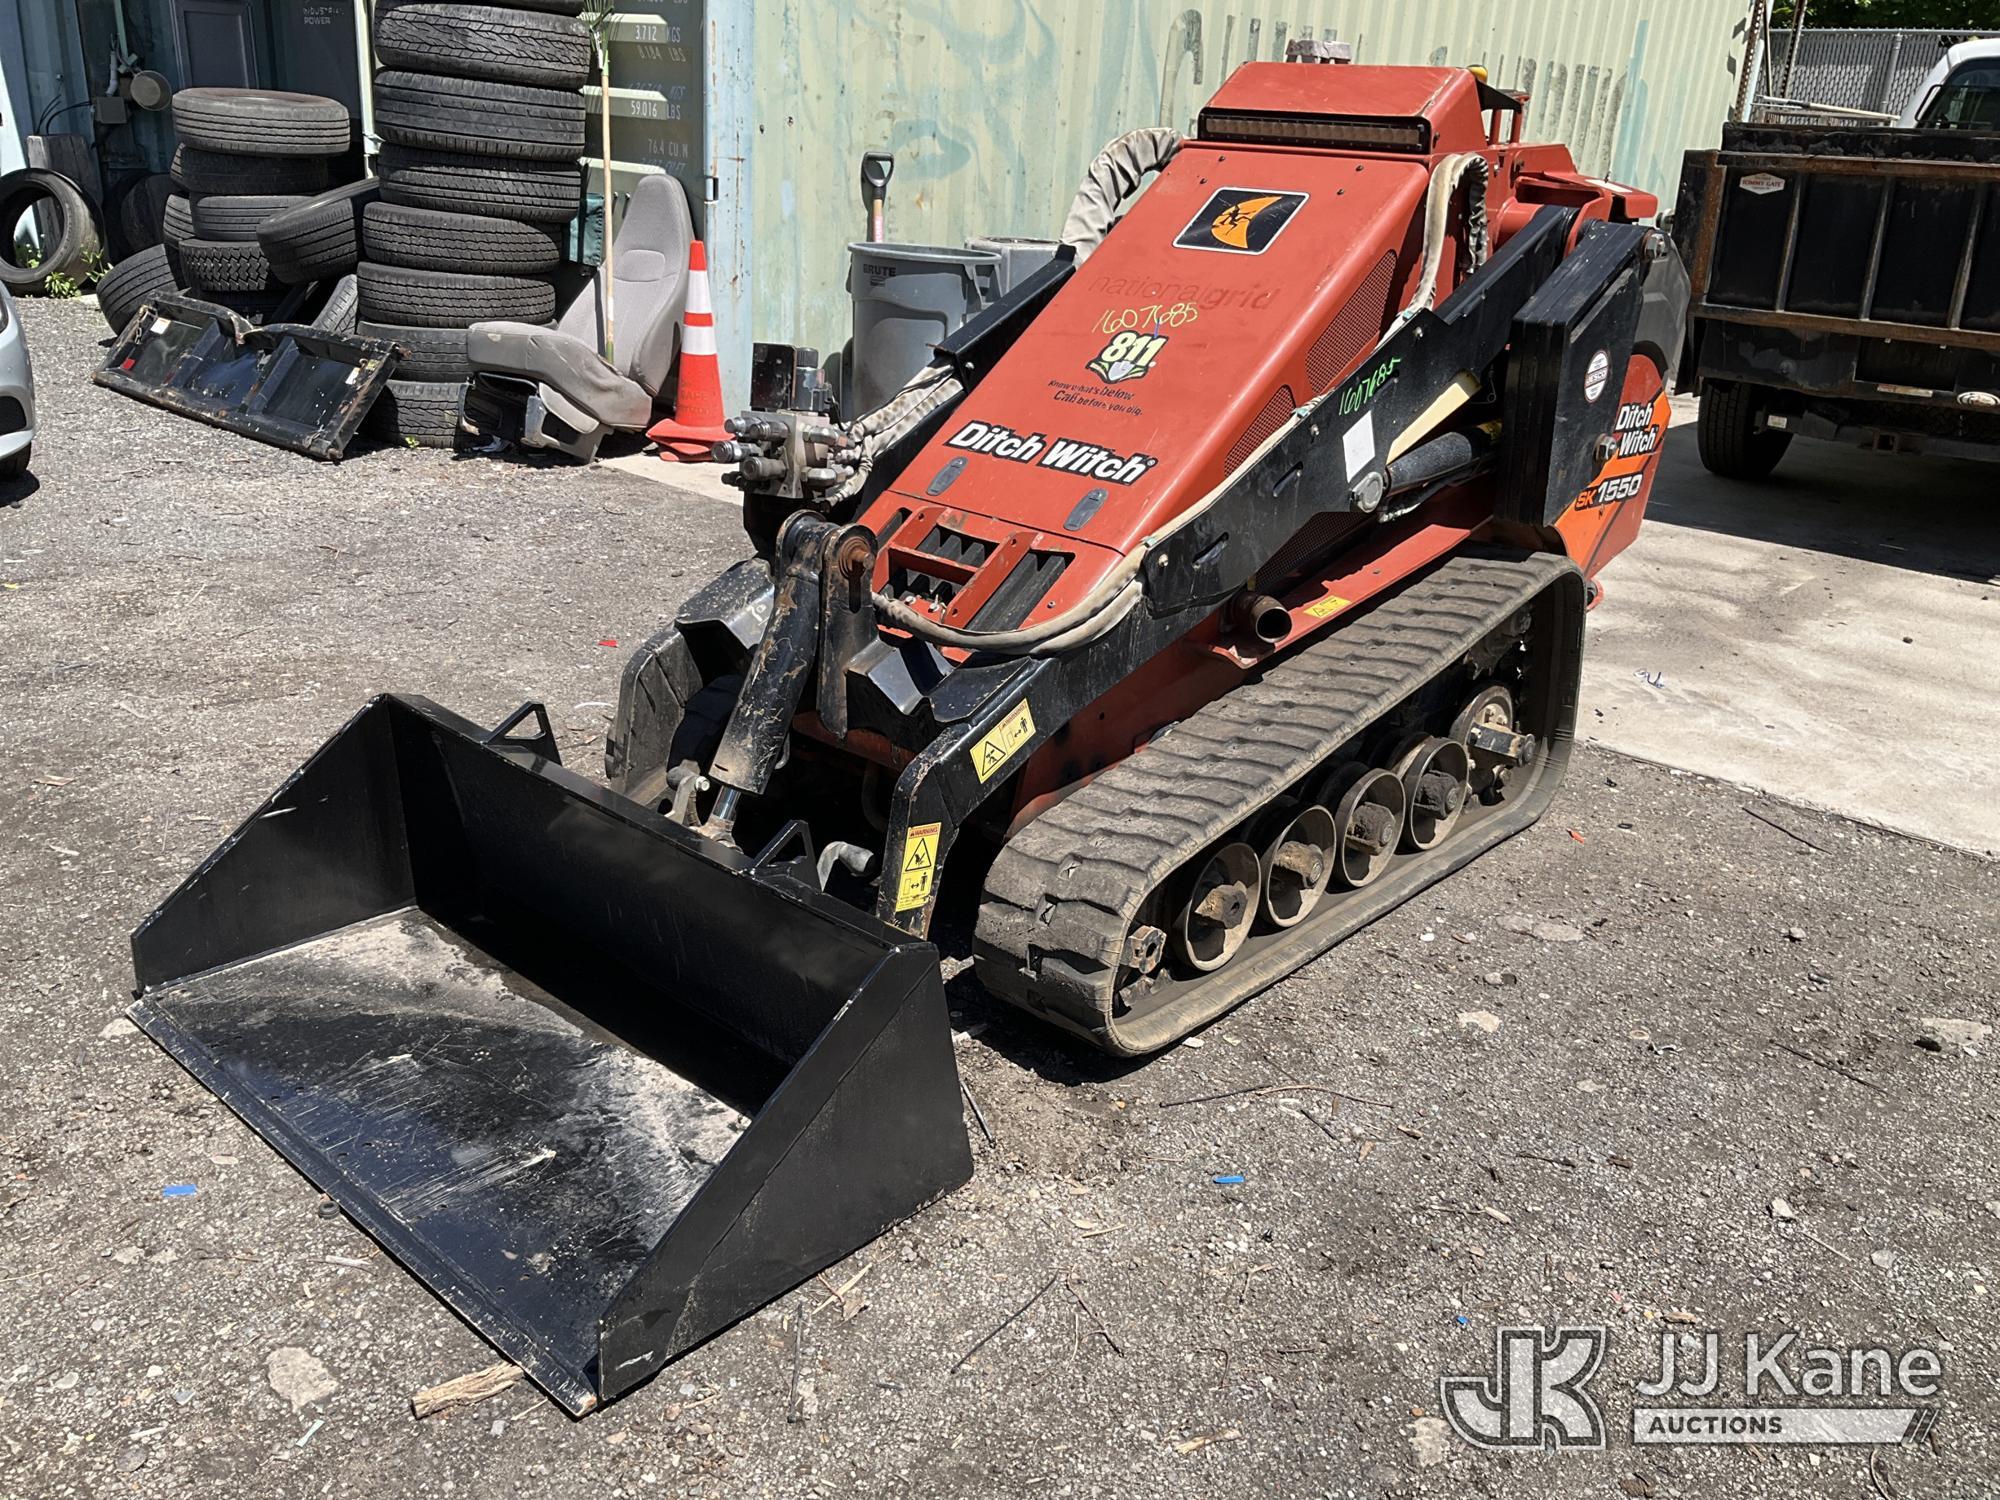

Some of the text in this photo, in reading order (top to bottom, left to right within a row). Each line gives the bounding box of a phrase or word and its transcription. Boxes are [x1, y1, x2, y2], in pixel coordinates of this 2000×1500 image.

[304, 16, 331, 24] POWER
[631, 100, 681, 120] 59.016 LBS
[863, 263, 897, 277] BRUTE
[1088, 275, 1281, 311] nationalgrid
[1092, 302, 1198, 334] 1607685
[1100, 330, 1169, 367] 811
[1053, 389, 1078, 403] Call
[1076, 396, 1108, 410] before
[1107, 403, 1126, 414] you
[1616, 403, 1652, 430] Ditch
[947, 421, 1149, 485] Ditch Witch
[1618, 428, 1657, 457] Witch
[1575, 473, 1643, 508] SK 1550
[914, 826, 938, 836] WARNING
